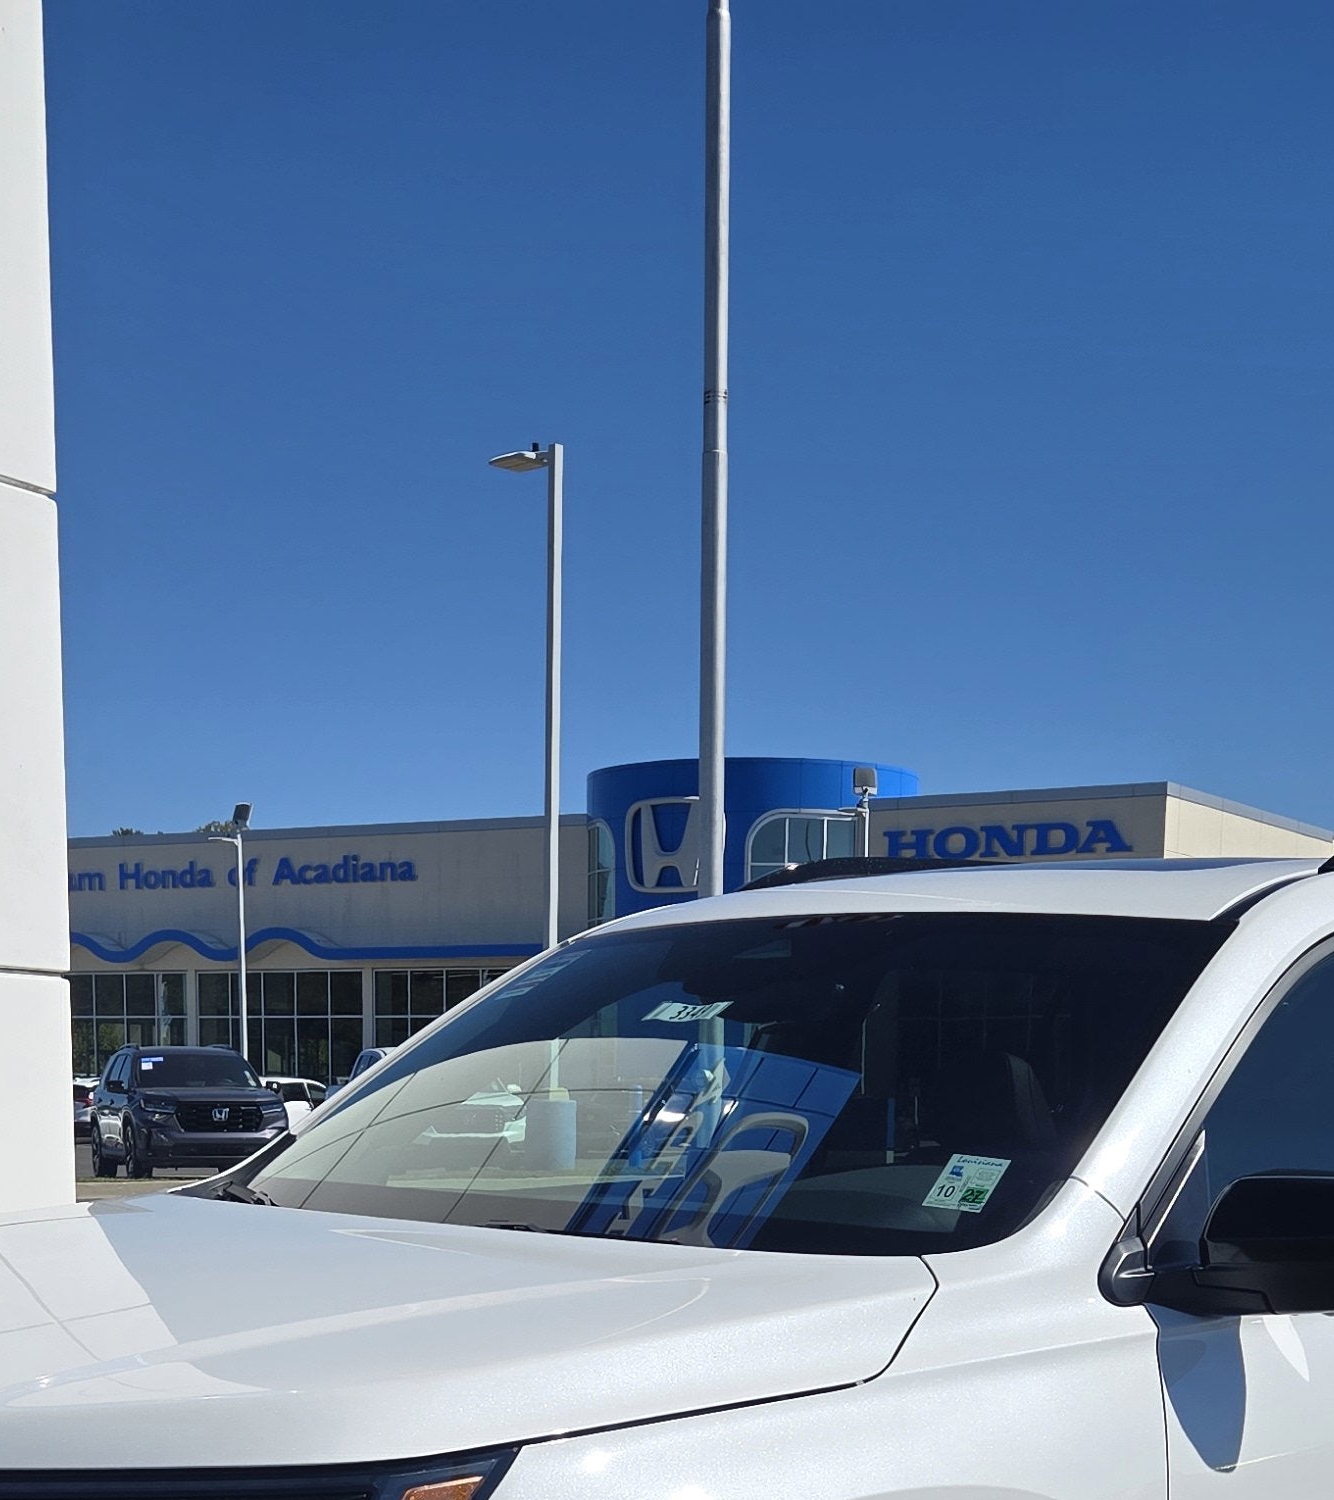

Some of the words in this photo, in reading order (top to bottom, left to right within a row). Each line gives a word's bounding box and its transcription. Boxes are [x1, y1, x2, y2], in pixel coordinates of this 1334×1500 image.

[883, 819, 1133, 859] HONDA
[118, 860, 215, 890] Honda
[227, 857, 258, 887] of
[272, 855, 417, 886] Acadiana
[956, 1155, 1003, 1168] Louisiana
[936, 1184, 956, 1198] 10
